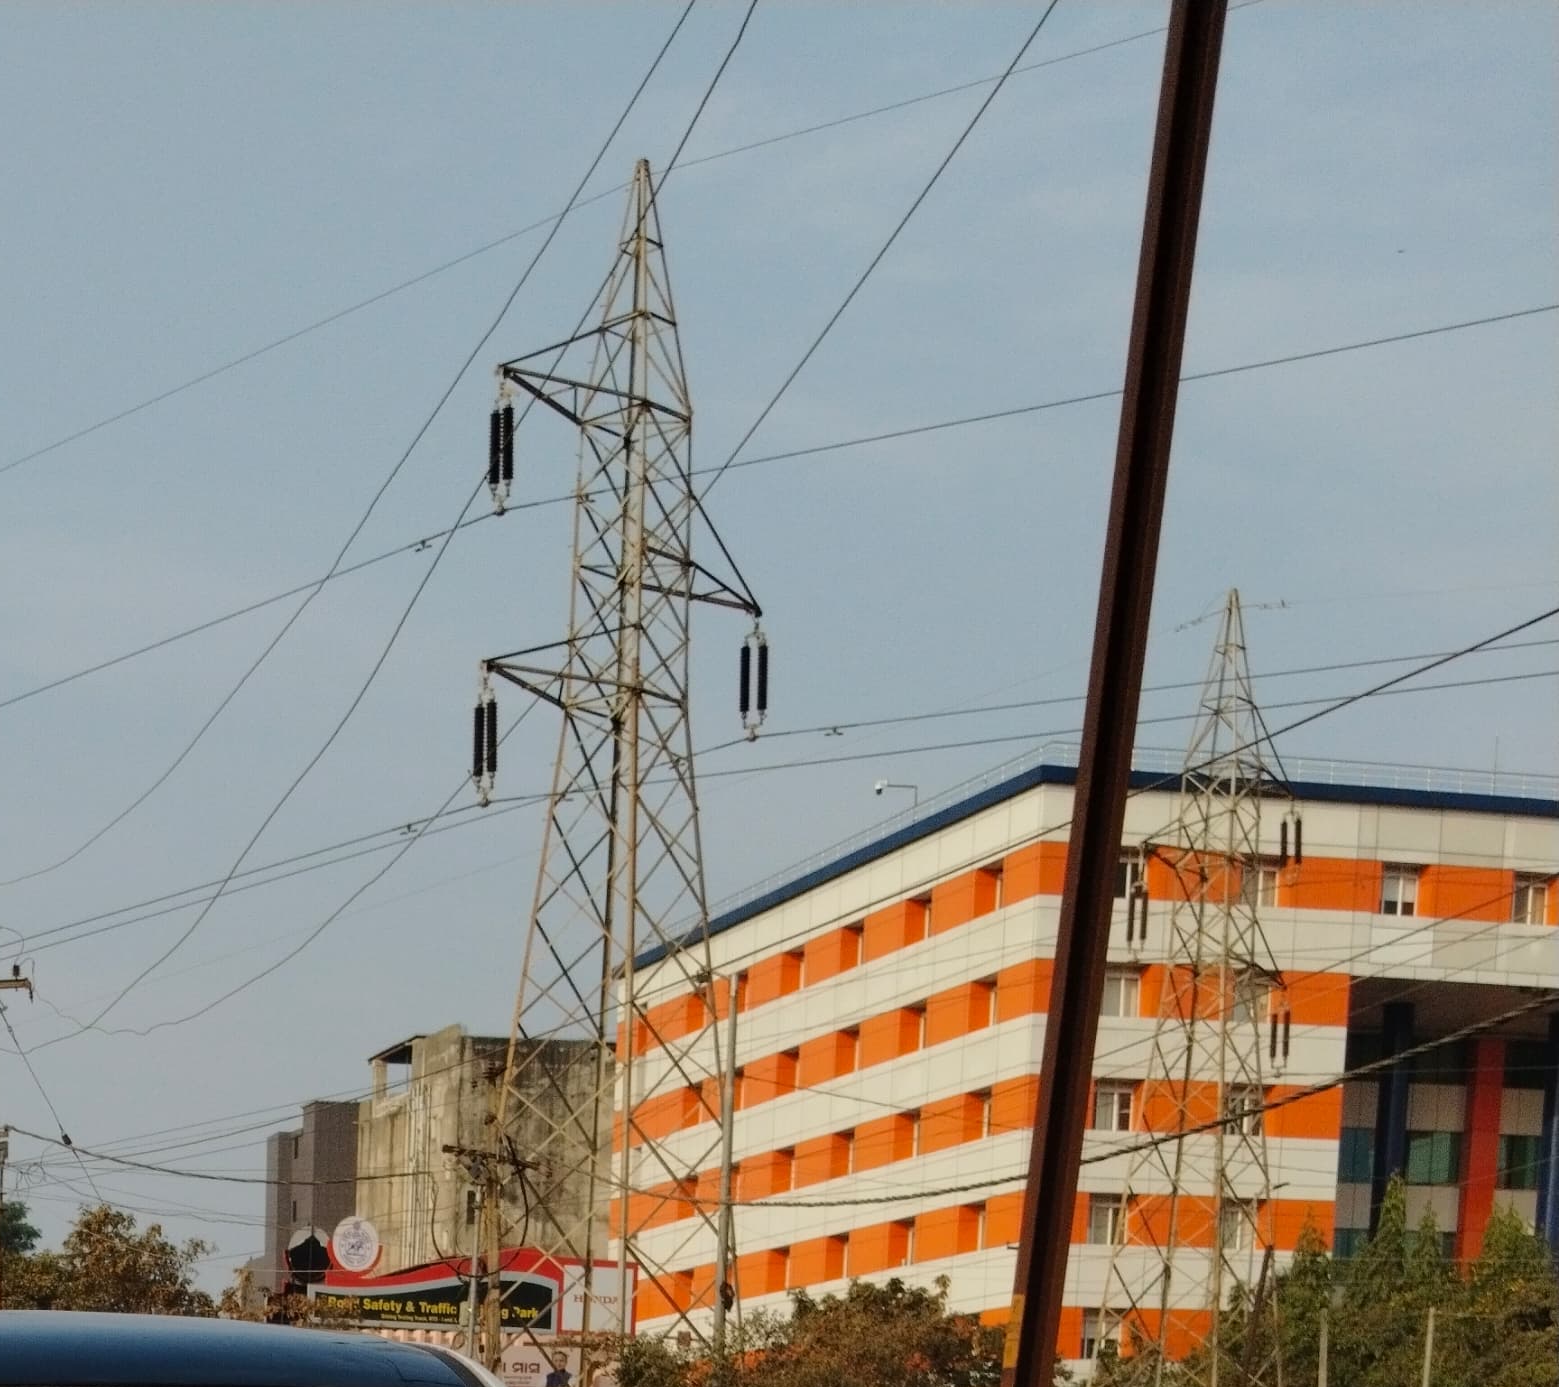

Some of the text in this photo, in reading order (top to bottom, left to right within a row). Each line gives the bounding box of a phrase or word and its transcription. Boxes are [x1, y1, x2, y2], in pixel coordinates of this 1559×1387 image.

[363, 1298, 402, 1313] Safety
[405, 1301, 415, 1312] &
[419, 1301, 457, 1314] Traffic
